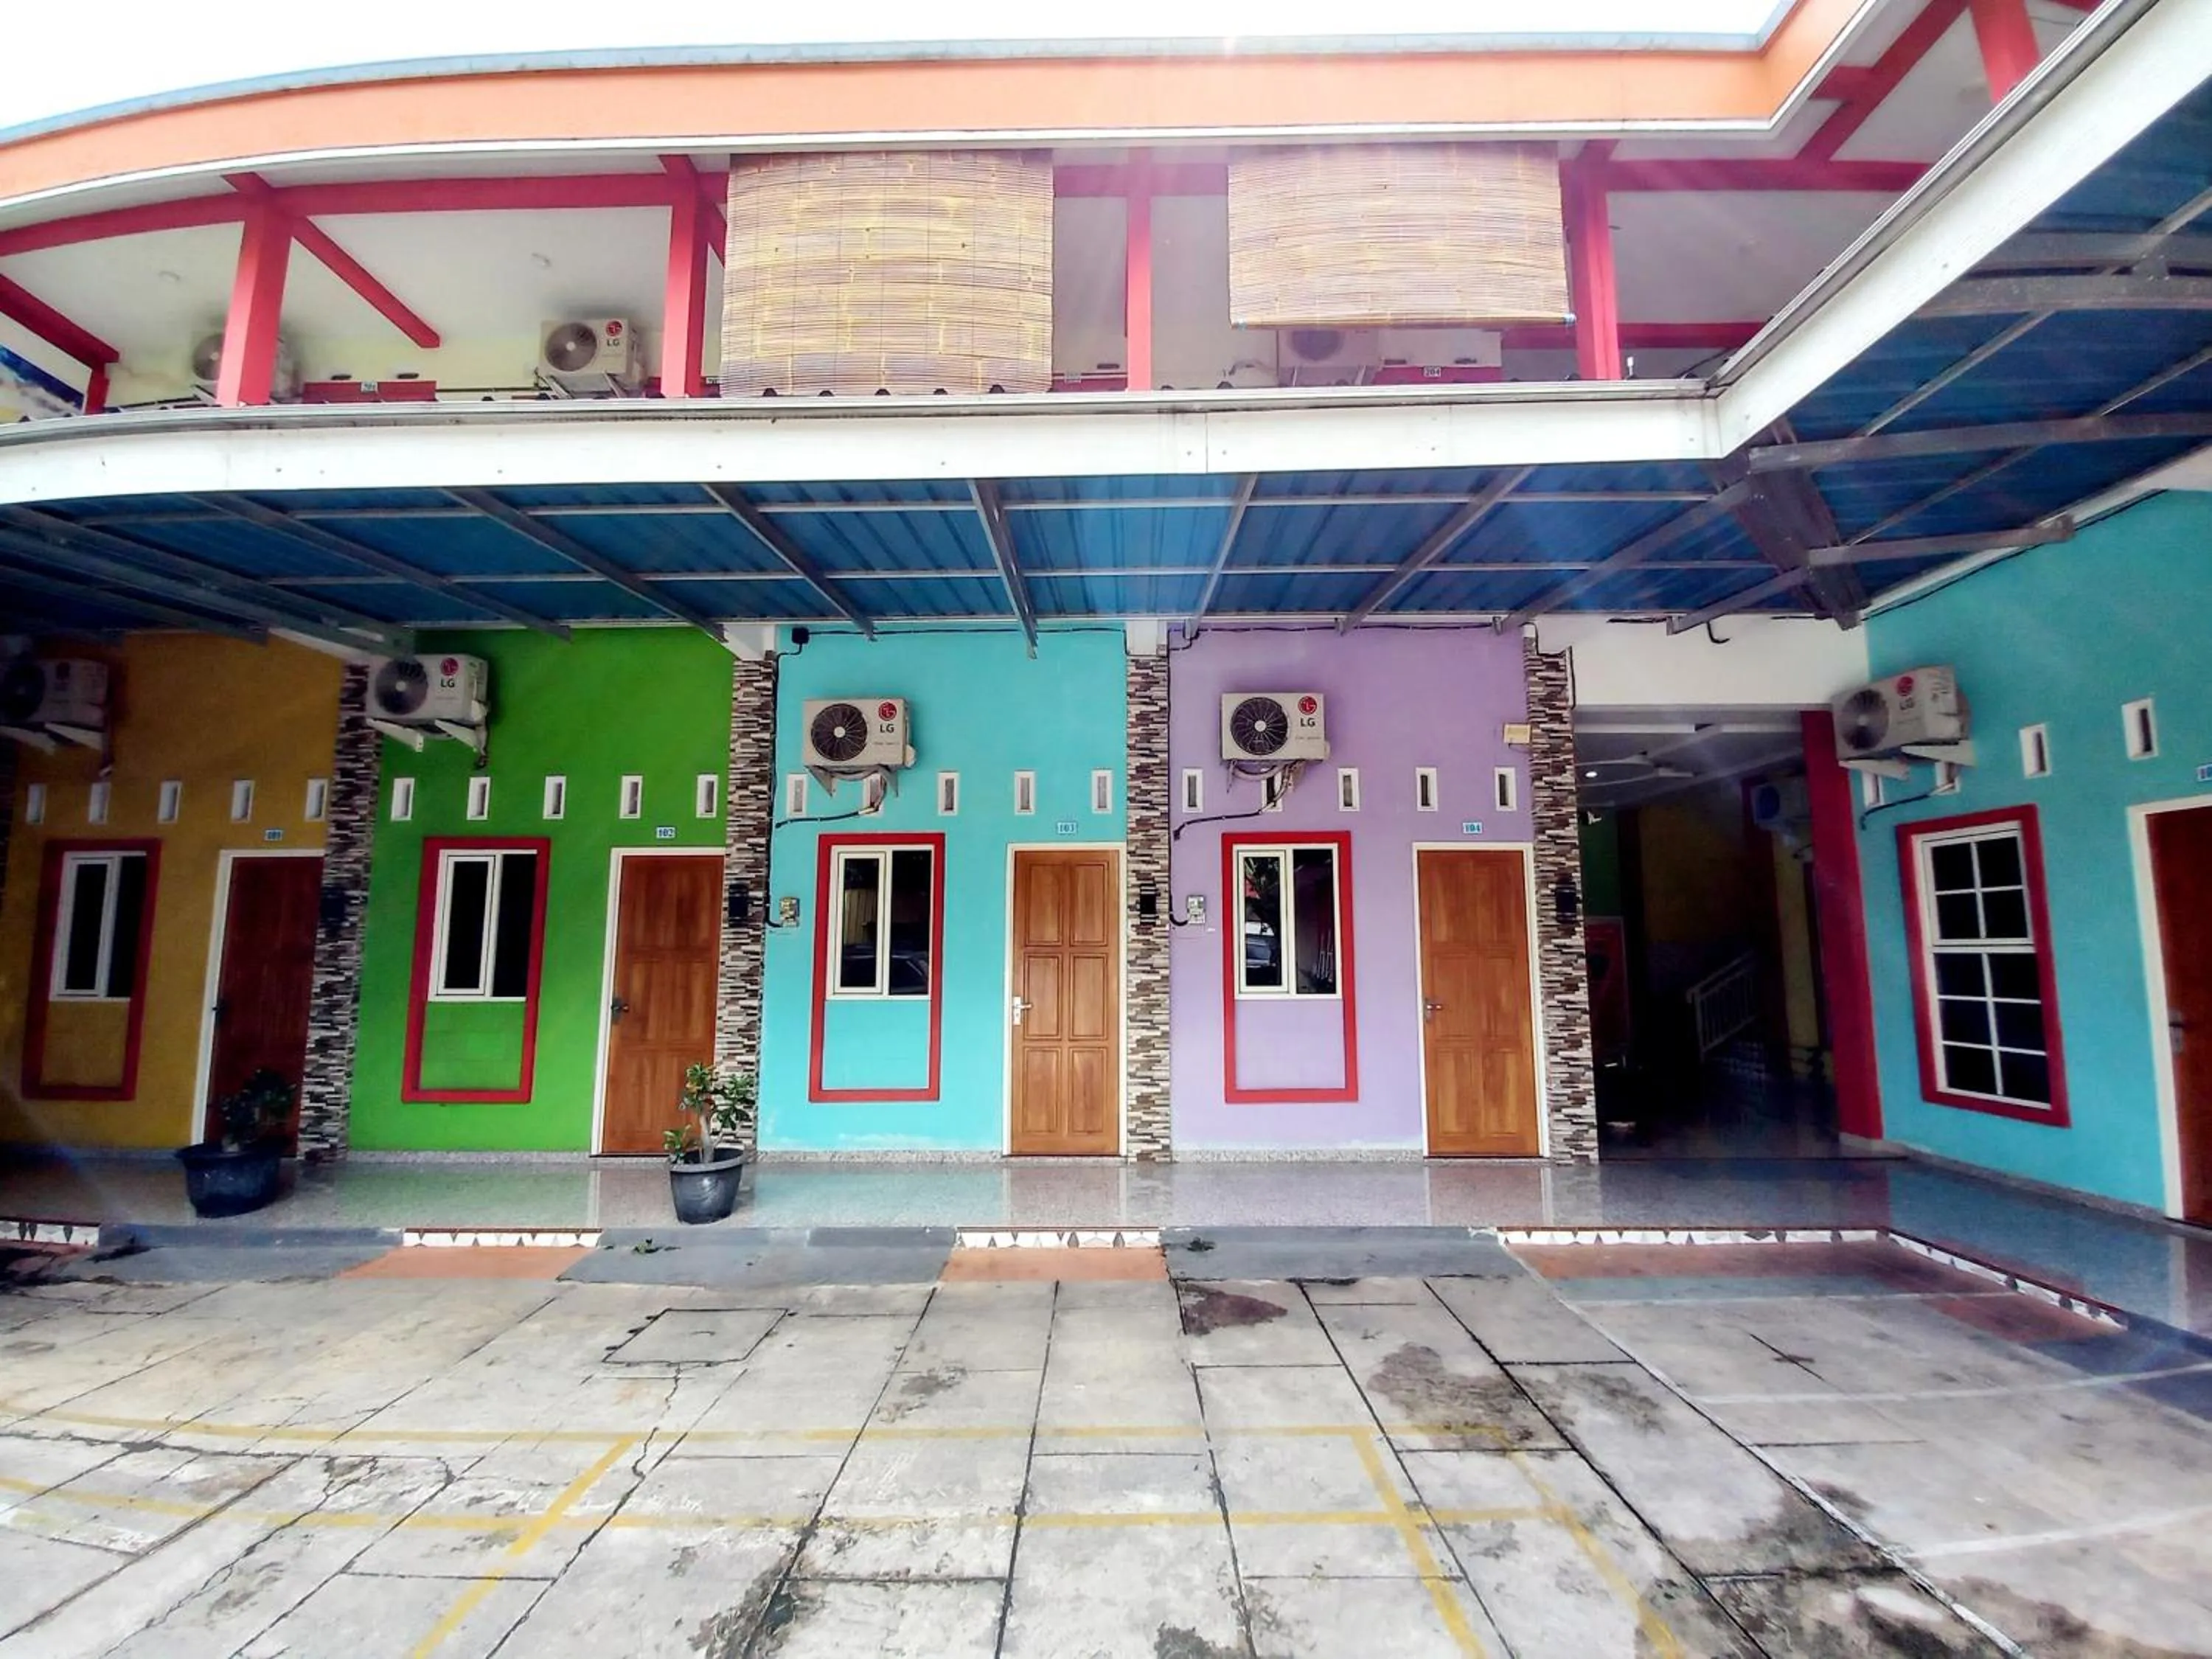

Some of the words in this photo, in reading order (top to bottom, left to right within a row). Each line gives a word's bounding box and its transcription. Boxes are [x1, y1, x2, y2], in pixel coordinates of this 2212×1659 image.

[607, 338, 620, 347] LG
[440, 678, 455, 688] LG
[1300, 717, 1316, 727] LG
[880, 723, 894, 734] LG
[1465, 824, 1480, 832] 104
